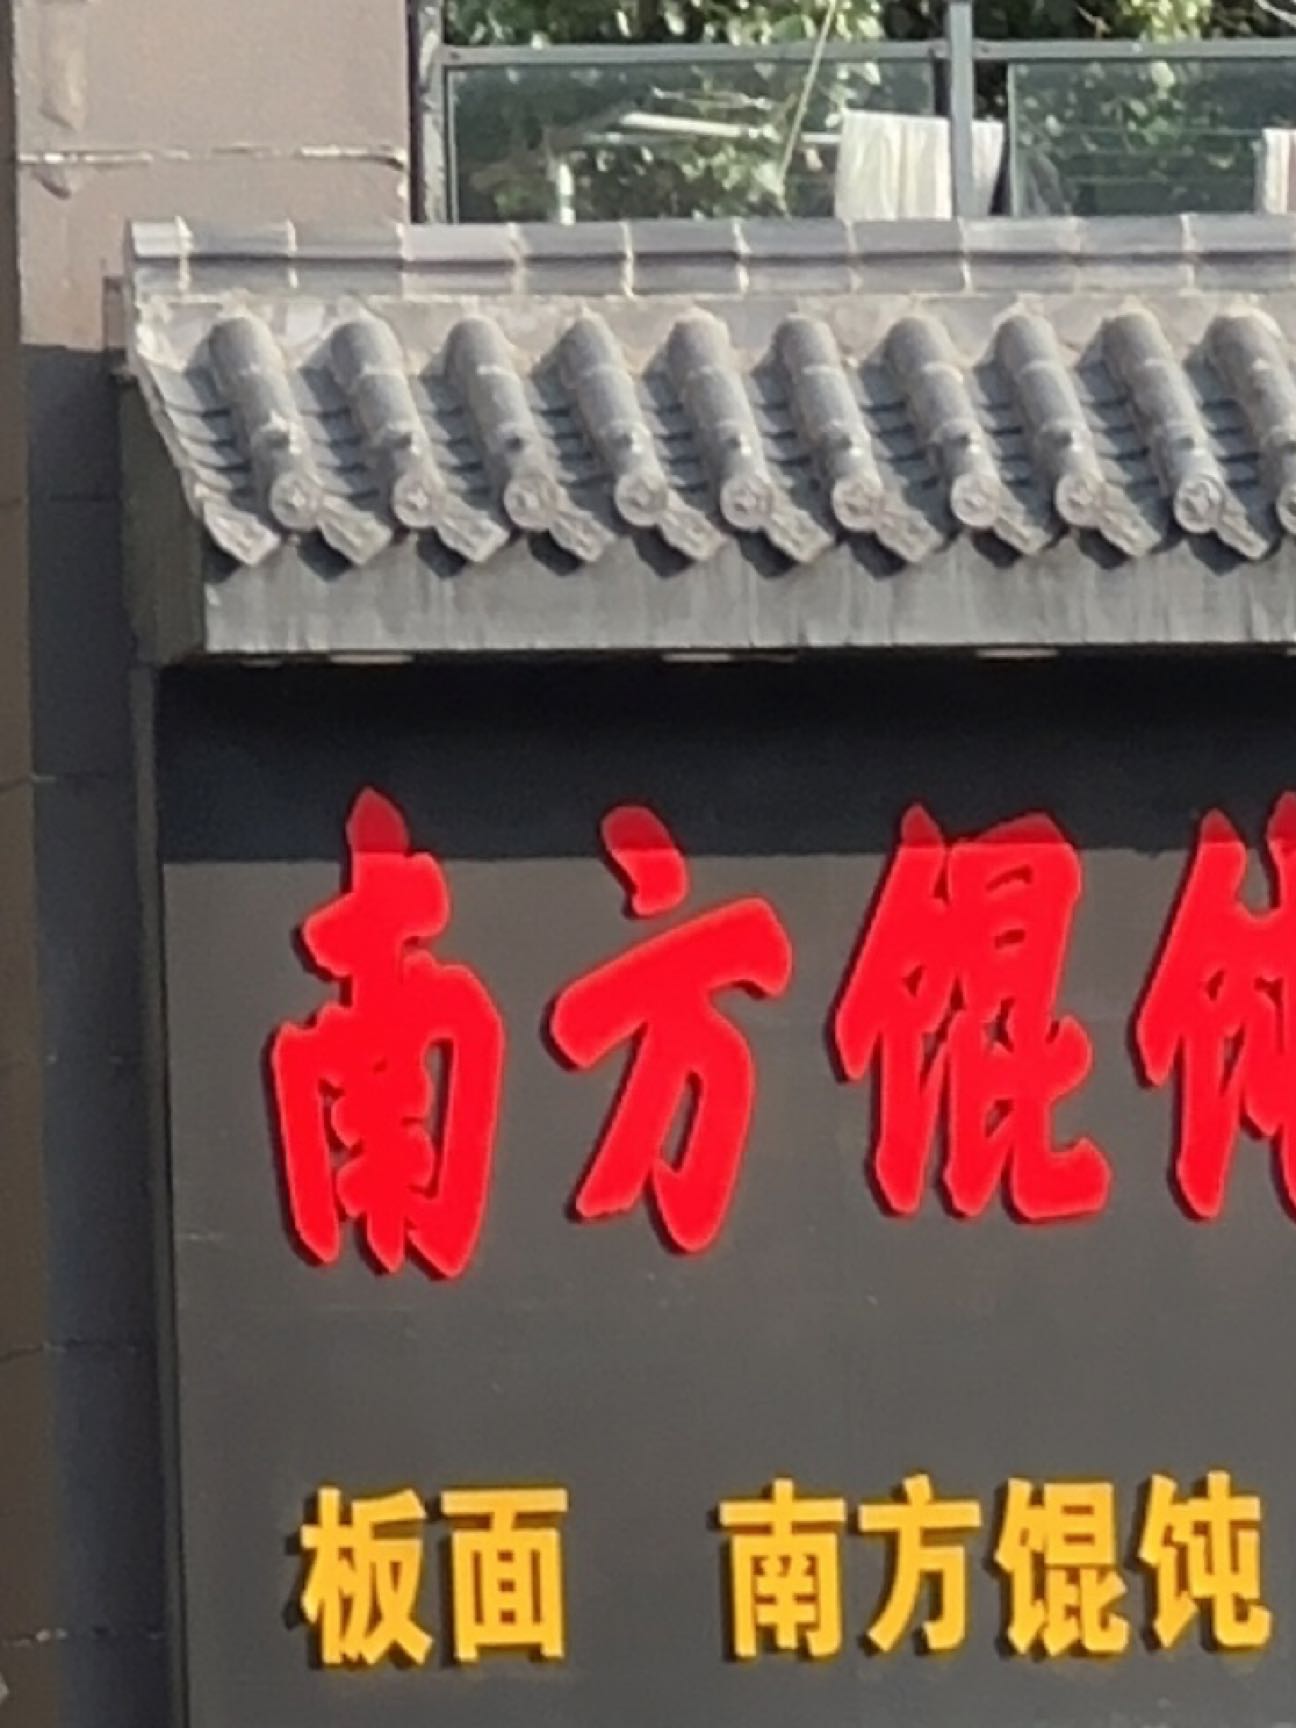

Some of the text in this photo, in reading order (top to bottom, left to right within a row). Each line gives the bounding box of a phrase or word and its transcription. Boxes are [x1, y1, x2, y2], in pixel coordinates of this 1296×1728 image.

[299, 1486, 568, 1668] 板面
[718, 1472, 1275, 1662] 南方馄饨
